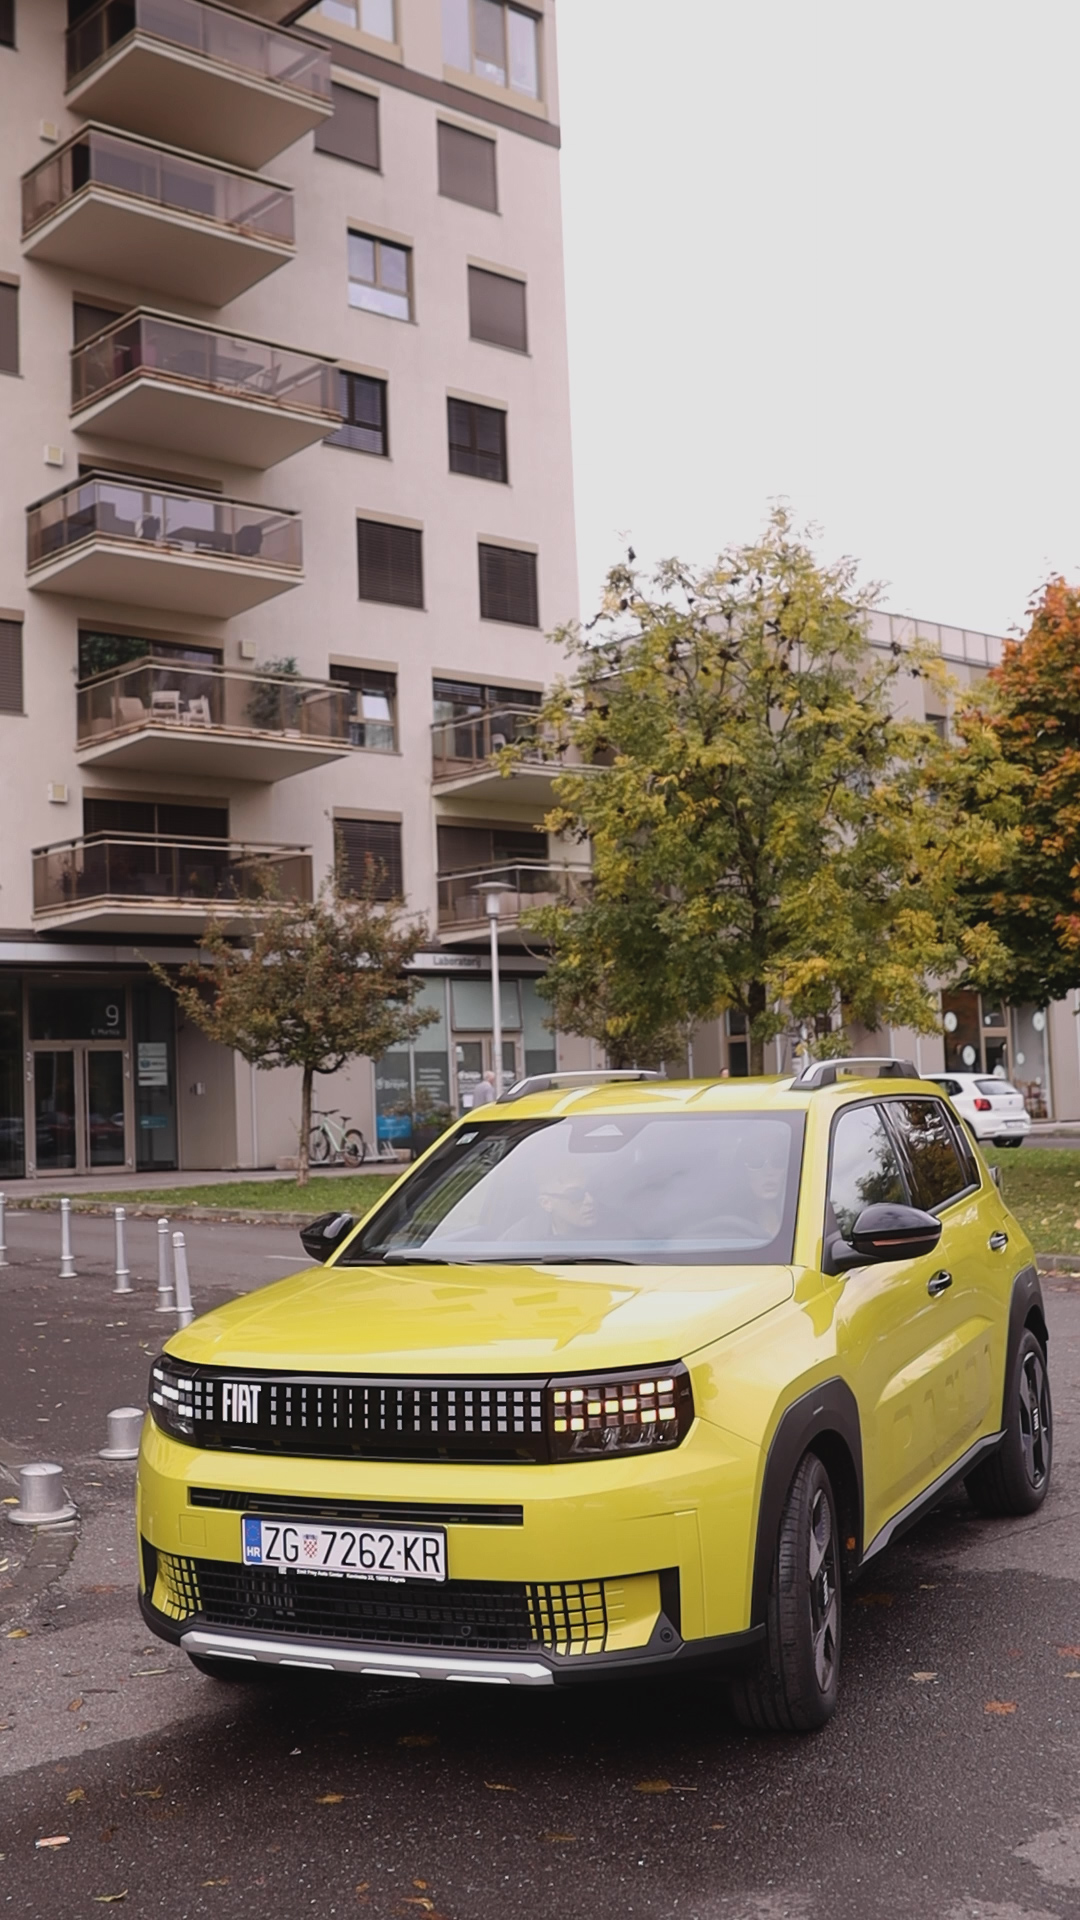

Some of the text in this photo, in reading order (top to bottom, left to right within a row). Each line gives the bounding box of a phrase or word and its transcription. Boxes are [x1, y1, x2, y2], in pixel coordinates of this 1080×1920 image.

[105, 1004, 120, 1027] 9
[222, 1382, 262, 1424] FIAT
[246, 1546, 261, 1558] HR
[264, 1526, 300, 1563] ZG
